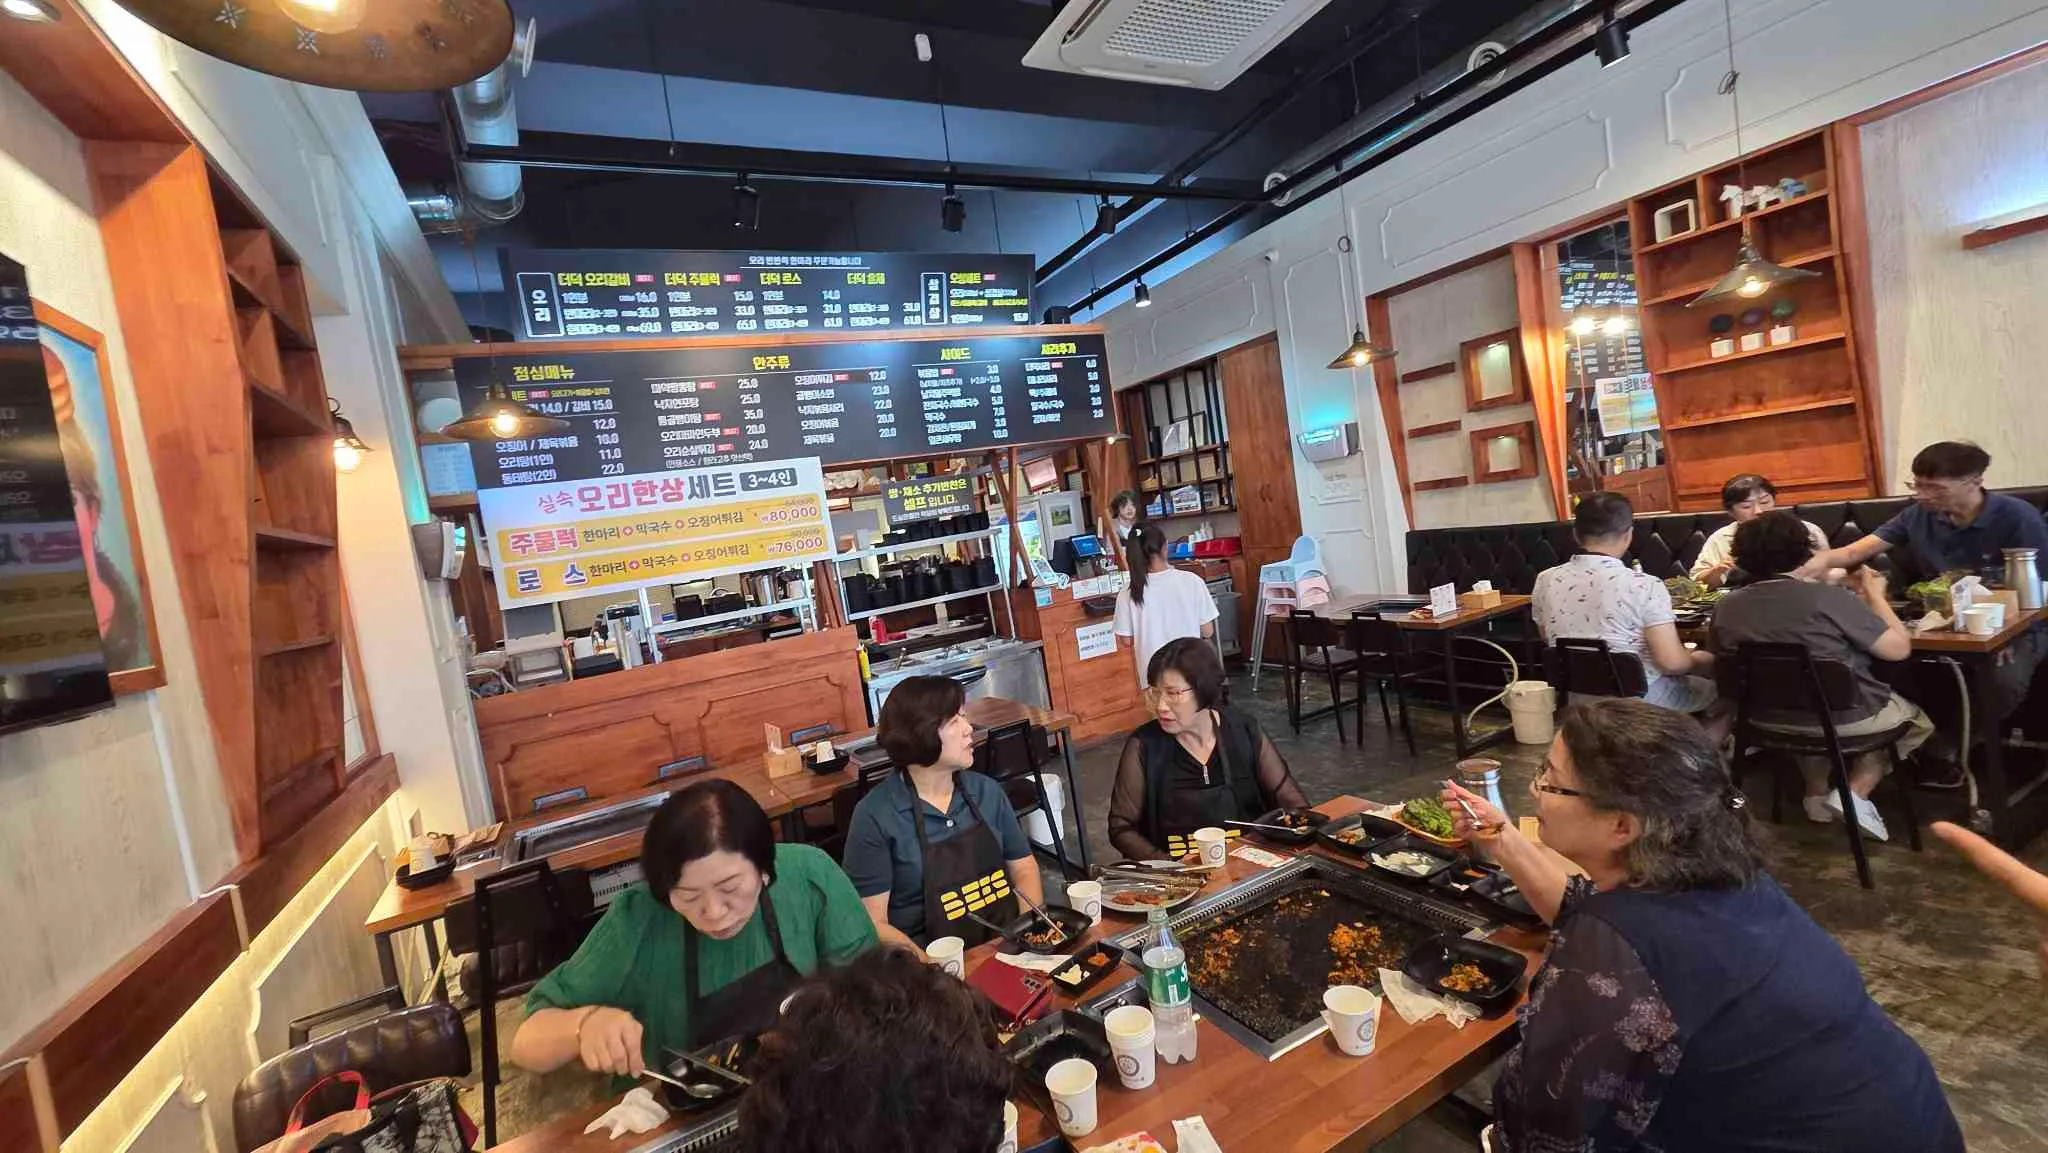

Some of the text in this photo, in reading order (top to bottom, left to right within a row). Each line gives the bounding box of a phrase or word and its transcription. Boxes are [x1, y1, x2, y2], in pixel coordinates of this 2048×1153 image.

[557, 272, 583, 286] 더덕
[664, 272, 687, 286] 더덕
[760, 272, 780, 285] 더덕
[846, 273, 866, 285] 더덕
[734, 305, 756, 316] 33.0
[753, 356, 791, 369] 안주류
[868, 371, 887, 381] 12.0
[738, 378, 758, 389] 25.0
[593, 399, 613, 410] 15.0
[740, 393, 761, 404] 25.0
[743, 409, 764, 420] 35.0
[593, 418, 616, 430] 12.0
[745, 424, 766, 435] 20.0
[748, 439, 768, 450] 24.0
[599, 449, 622, 460] 11.0
[601, 463, 625, 475] 22.0
[538, 490, 573, 514] 실속
[748, 469, 792, 488] 3~4인
[904, 496, 927, 511] 셀프
[510, 527, 578, 554] 주물럭
[583, 526, 620, 543] 한마리
[635, 521, 673, 536] 막국수
[687, 511, 744, 528] 오징어튀김
[590, 560, 628, 577] 한마리
[642, 554, 678, 569] 막국수
[694, 543, 750, 561] 오징어튀김
